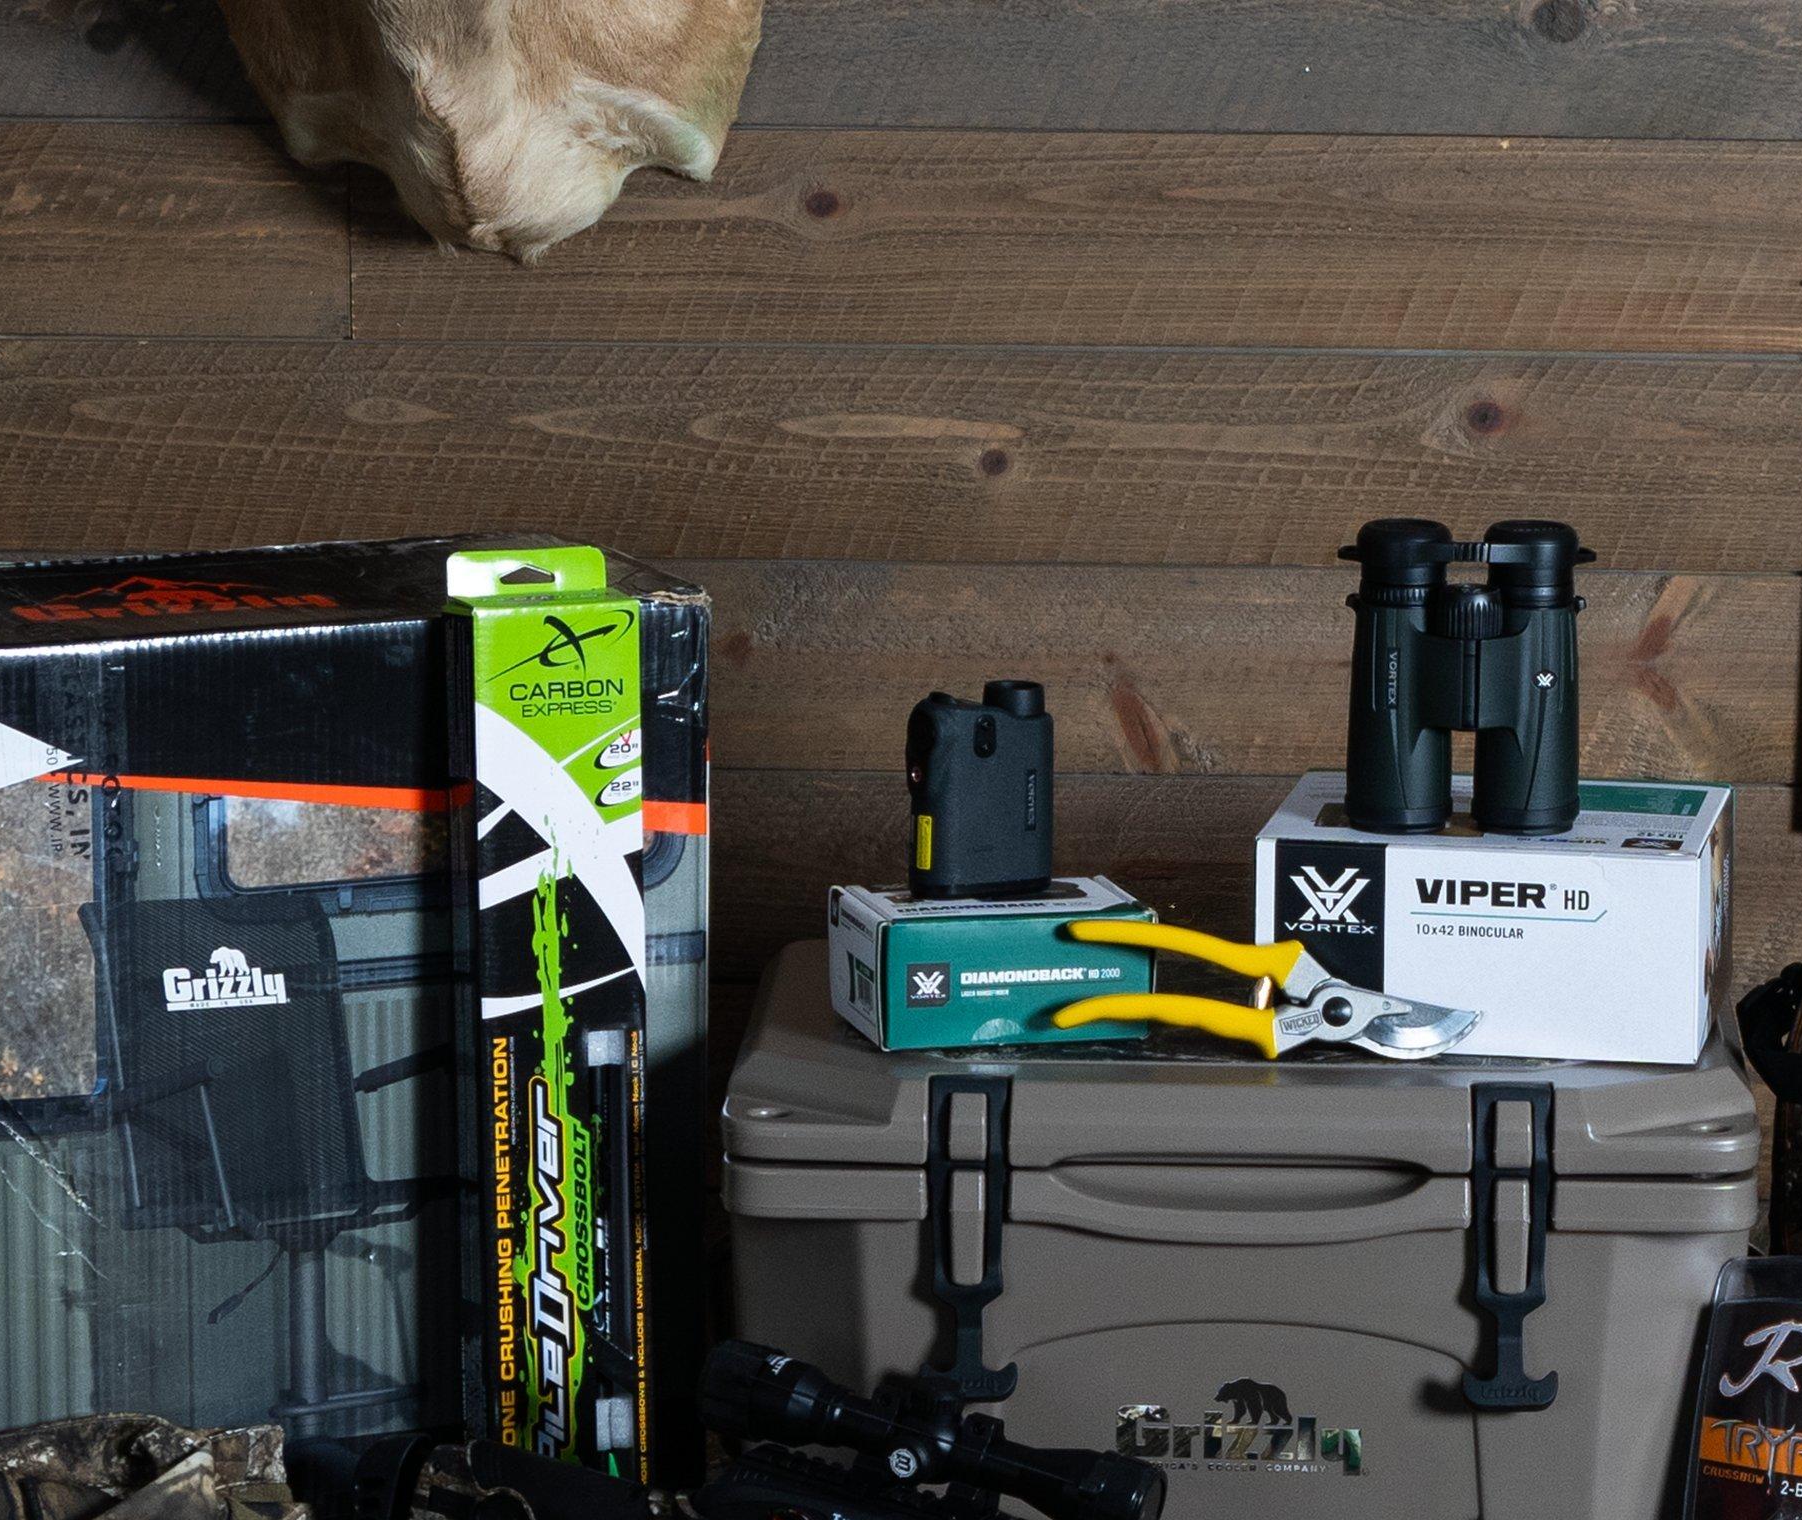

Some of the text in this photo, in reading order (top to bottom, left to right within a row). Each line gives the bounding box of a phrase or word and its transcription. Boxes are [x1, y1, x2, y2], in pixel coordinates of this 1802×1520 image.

[509, 678, 624, 701] CARBON
[1387, 651, 1399, 706] VORTEX
[521, 700, 614, 718] EXPRESS
[1415, 878, 1590, 911] VIPER HD
[1285, 921, 1376, 936] VORTEX
[1415, 923, 1525, 940] 10x42 BINOCULAR
[163, 967, 287, 1004] Grizzly
[960, 968, 1084, 985] DIAMONDBACK
[1100, 968, 1122, 979] 2000
[1282, 1011, 1322, 1033] WICKED
[492, 1036, 514, 1230] PENETRATION
[576, 1129, 592, 1305] CROSSBOLT
[635, 1247, 645, 1309] UNIVERSAL
[495, 1238, 517, 1383] CRUSHING
[636, 1311, 645, 1367] INCLUDES
[500, 1390, 517, 1448] ONE
[638, 1381, 647, 1452] CROSSBOWS
[1115, 1404, 1364, 1476] Grizzly
[1148, 1461, 1327, 1473] RICA'S COOLER COMPANY
